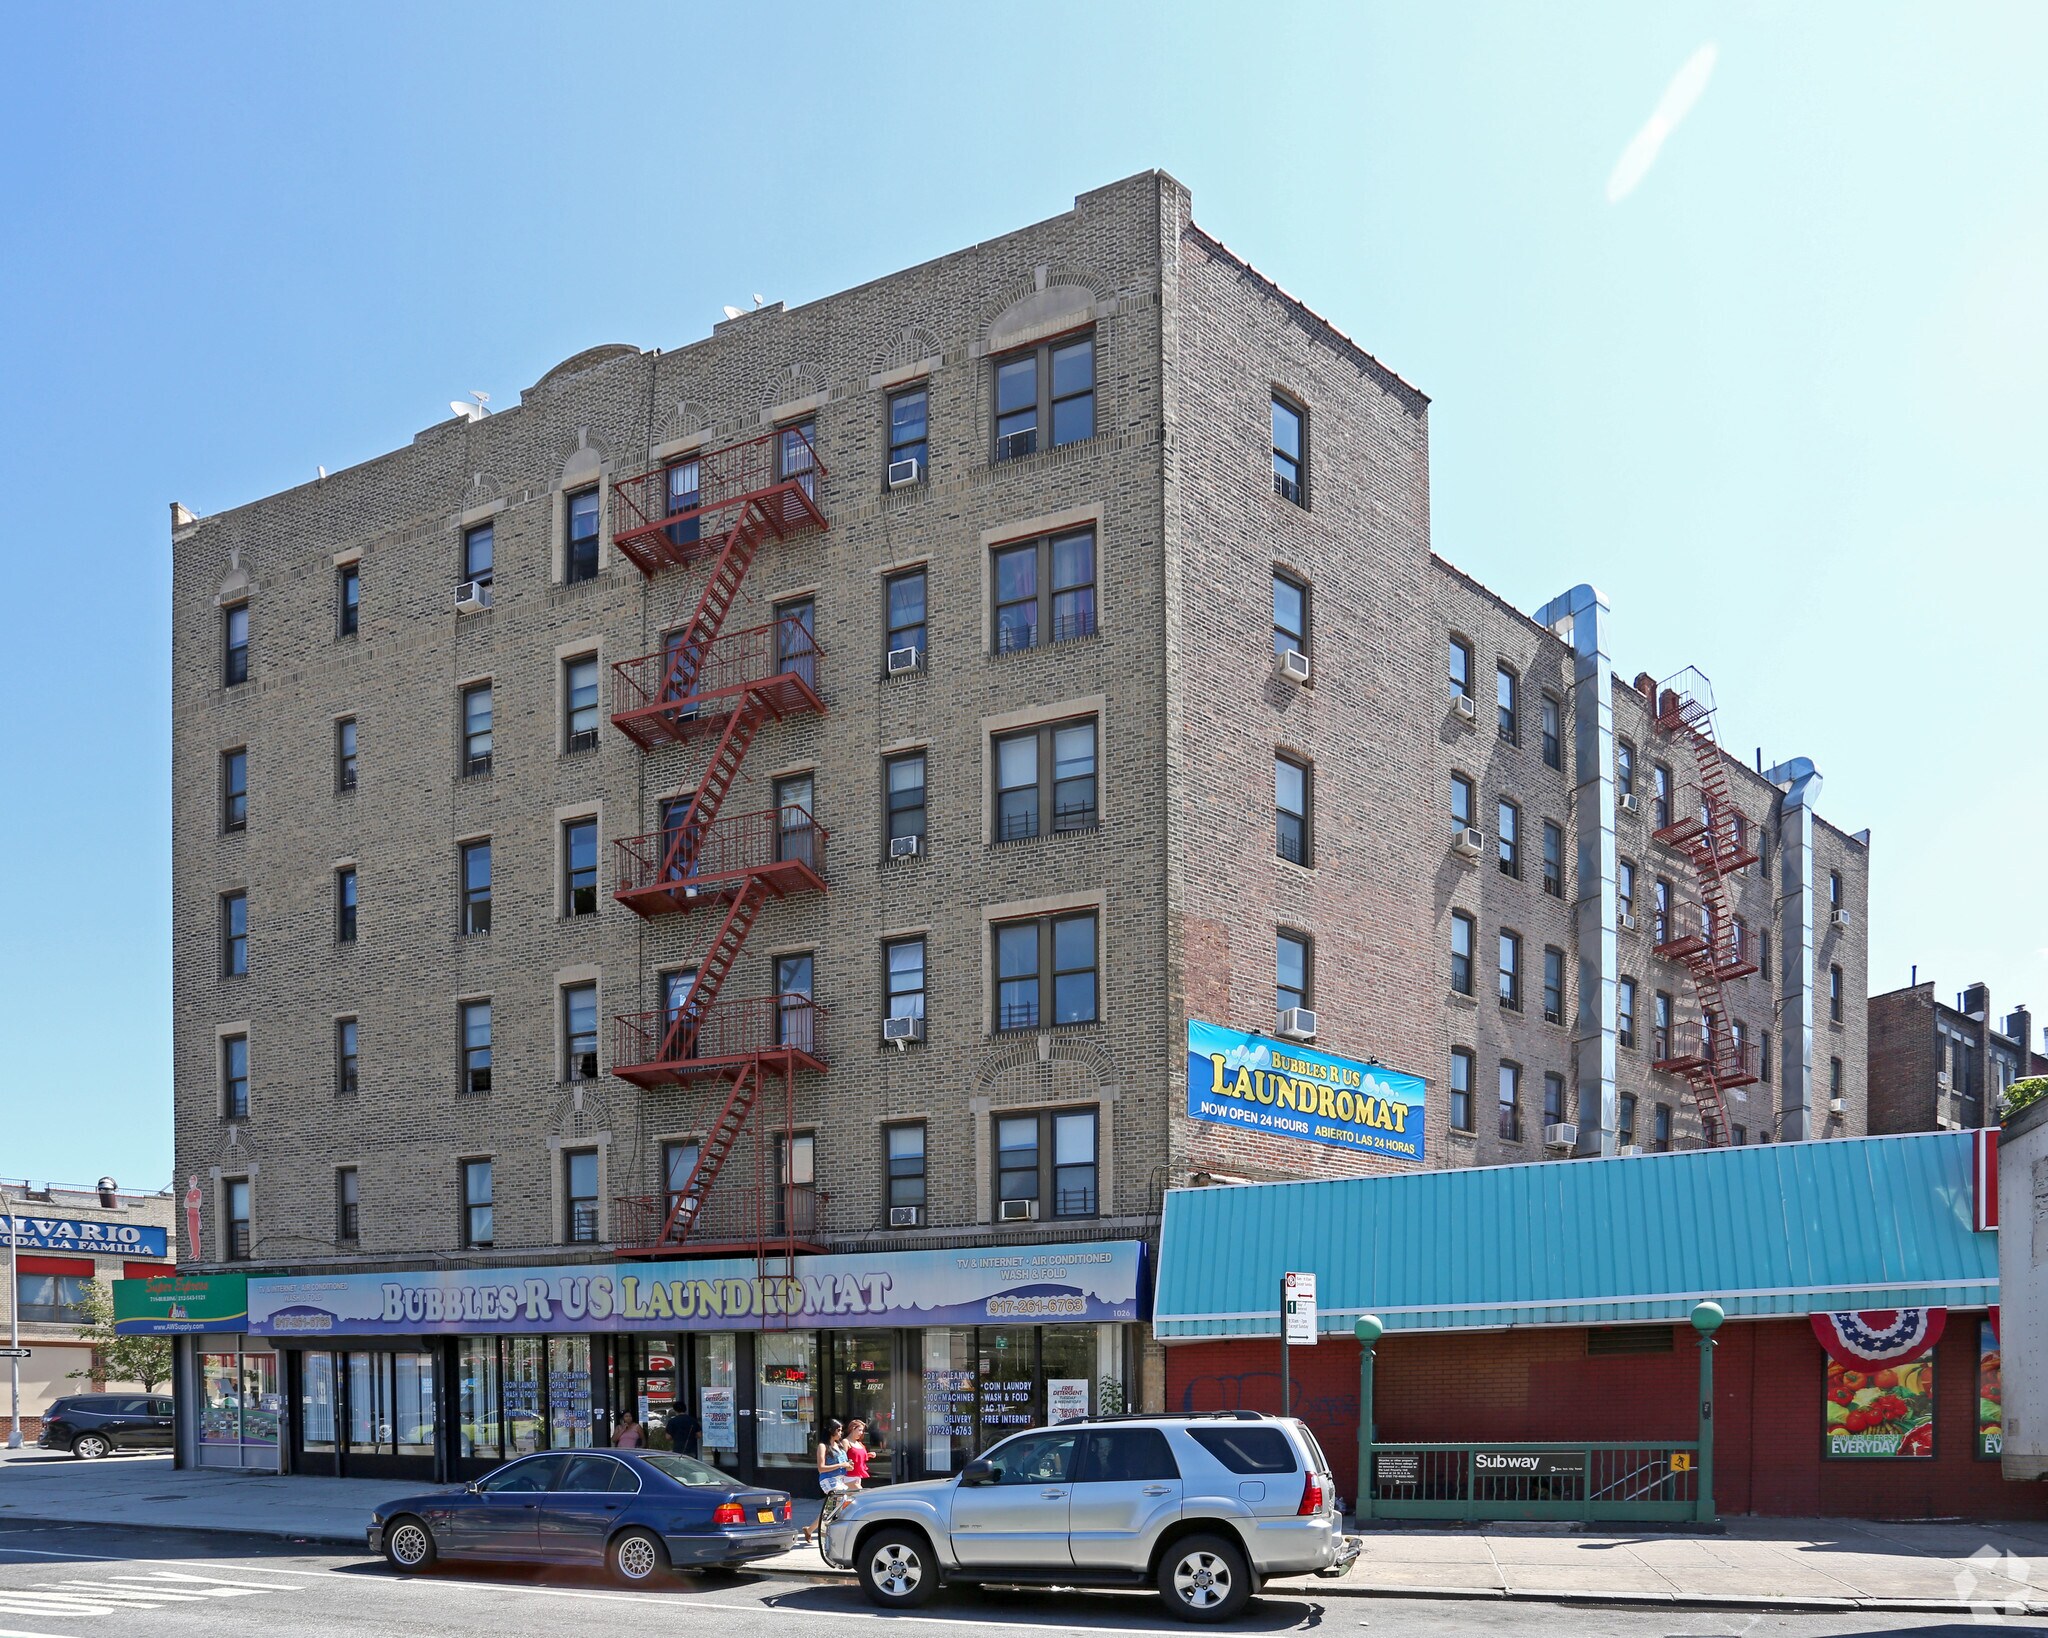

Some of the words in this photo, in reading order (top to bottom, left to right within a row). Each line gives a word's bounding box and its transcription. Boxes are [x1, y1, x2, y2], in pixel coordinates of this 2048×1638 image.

[1271, 1051, 1327, 1079] BUBBLES
[1329, 1065, 1340, 1083] R
[1342, 1068, 1361, 1087] US
[1210, 1053, 1409, 1133] LAUNDROMAT
[1201, 1101, 1228, 1117] NOW
[1229, 1107, 1258, 1124] OPEN
[1260, 1114, 1272, 1127] 24
[1273, 1116, 1309, 1134] HOURS
[1314, 1125, 1354, 1143] ABIERTO
[1355, 1133, 1373, 1146] LAS
[1374, 1138, 1385, 1149] 24
[1386, 1139, 1415, 1154] HORAS
[47, 1238, 73, 1249] LA
[77, 1240, 155, 1255] FAMILIA
[957, 1259, 970, 1269] TV
[970, 1258, 978, 1268] &
[979, 1257, 1023, 1267] INTERNET
[1031, 1256, 1047, 1266] AIR
[1049, 1253, 1112, 1265] CONDITIONED
[1000, 1270, 1029, 1280] WASH
[1031, 1269, 1039, 1279] &
[1041, 1268, 1067, 1279] FOLD
[381, 1282, 518, 1323] BUBBLES
[523, 1278, 553, 1321] R
[559, 1275, 614, 1321] US
[621, 1272, 893, 1321] LAUNDROMAT
[989, 1299, 1083, 1314] 917-261-6763
[942, 1371, 975, 1380] CLEANING
[927, 1382, 944, 1391] OPEN
[984, 1382, 1001, 1391] COIN
[1003, 1381, 1032, 1390] LAUNDRY
[984, 1393, 1002, 1402] WASH
[1004, 1393, 1009, 1402] &
[1011, 1393, 1029, 1402] FOLD
[927, 1404, 950, 1412] PICKUP
[944, 1415, 972, 1423] DELIVERY
[984, 1415, 999, 1424] FREE
[1001, 1415, 1031, 1424] INTERNET
[927, 1425, 972, 1436] 917-261-6763
[1832, 1434, 1872, 1442] AVAILABLE
[1831, 1440, 1899, 1454] EVERYDAY
[1475, 1454, 1540, 1471] Subway
